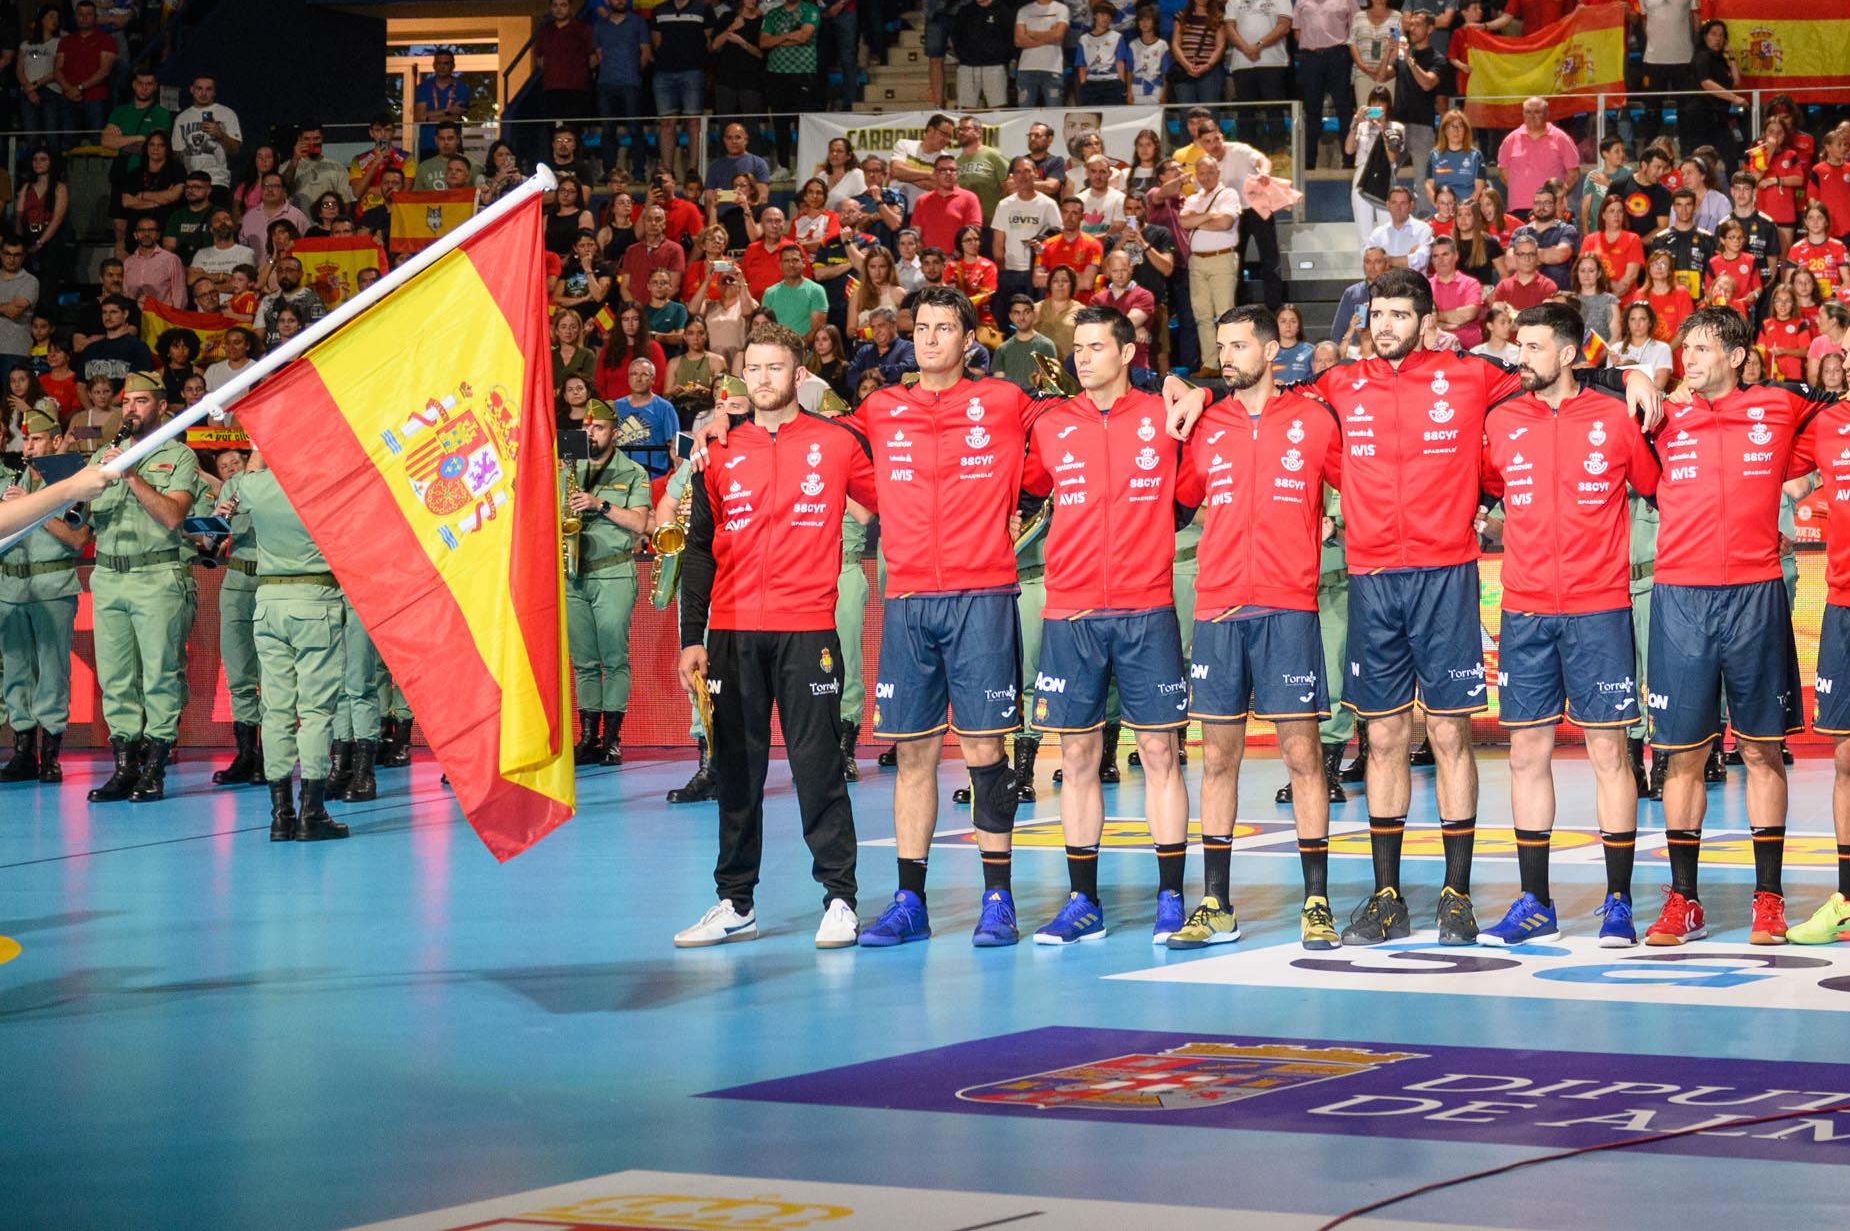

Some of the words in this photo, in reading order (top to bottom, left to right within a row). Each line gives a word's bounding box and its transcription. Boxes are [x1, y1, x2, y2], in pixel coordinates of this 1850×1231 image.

[1809, 258, 1825, 270] 26
[1347, 413, 1373, 421] Santander
[1424, 430, 1458, 440] sacyr
[1668, 438, 1698, 447] Santander
[1352, 445, 1374, 455] AVIS
[961, 455, 993, 466] sacyr
[1744, 453, 1772, 461] sacyr
[895, 467, 916, 482] AVIS
[1672, 467, 1696, 480] AVIS
[1130, 478, 1161, 488] sacyr
[1275, 478, 1305, 489] sacyr
[1578, 482, 1609, 491] sacyr
[1060, 492, 1084, 505] AVIS
[794, 504, 826, 513] sacyr
[1034, 672, 1066, 694] AON
[1307, 1094, 1540, 1123] DE
